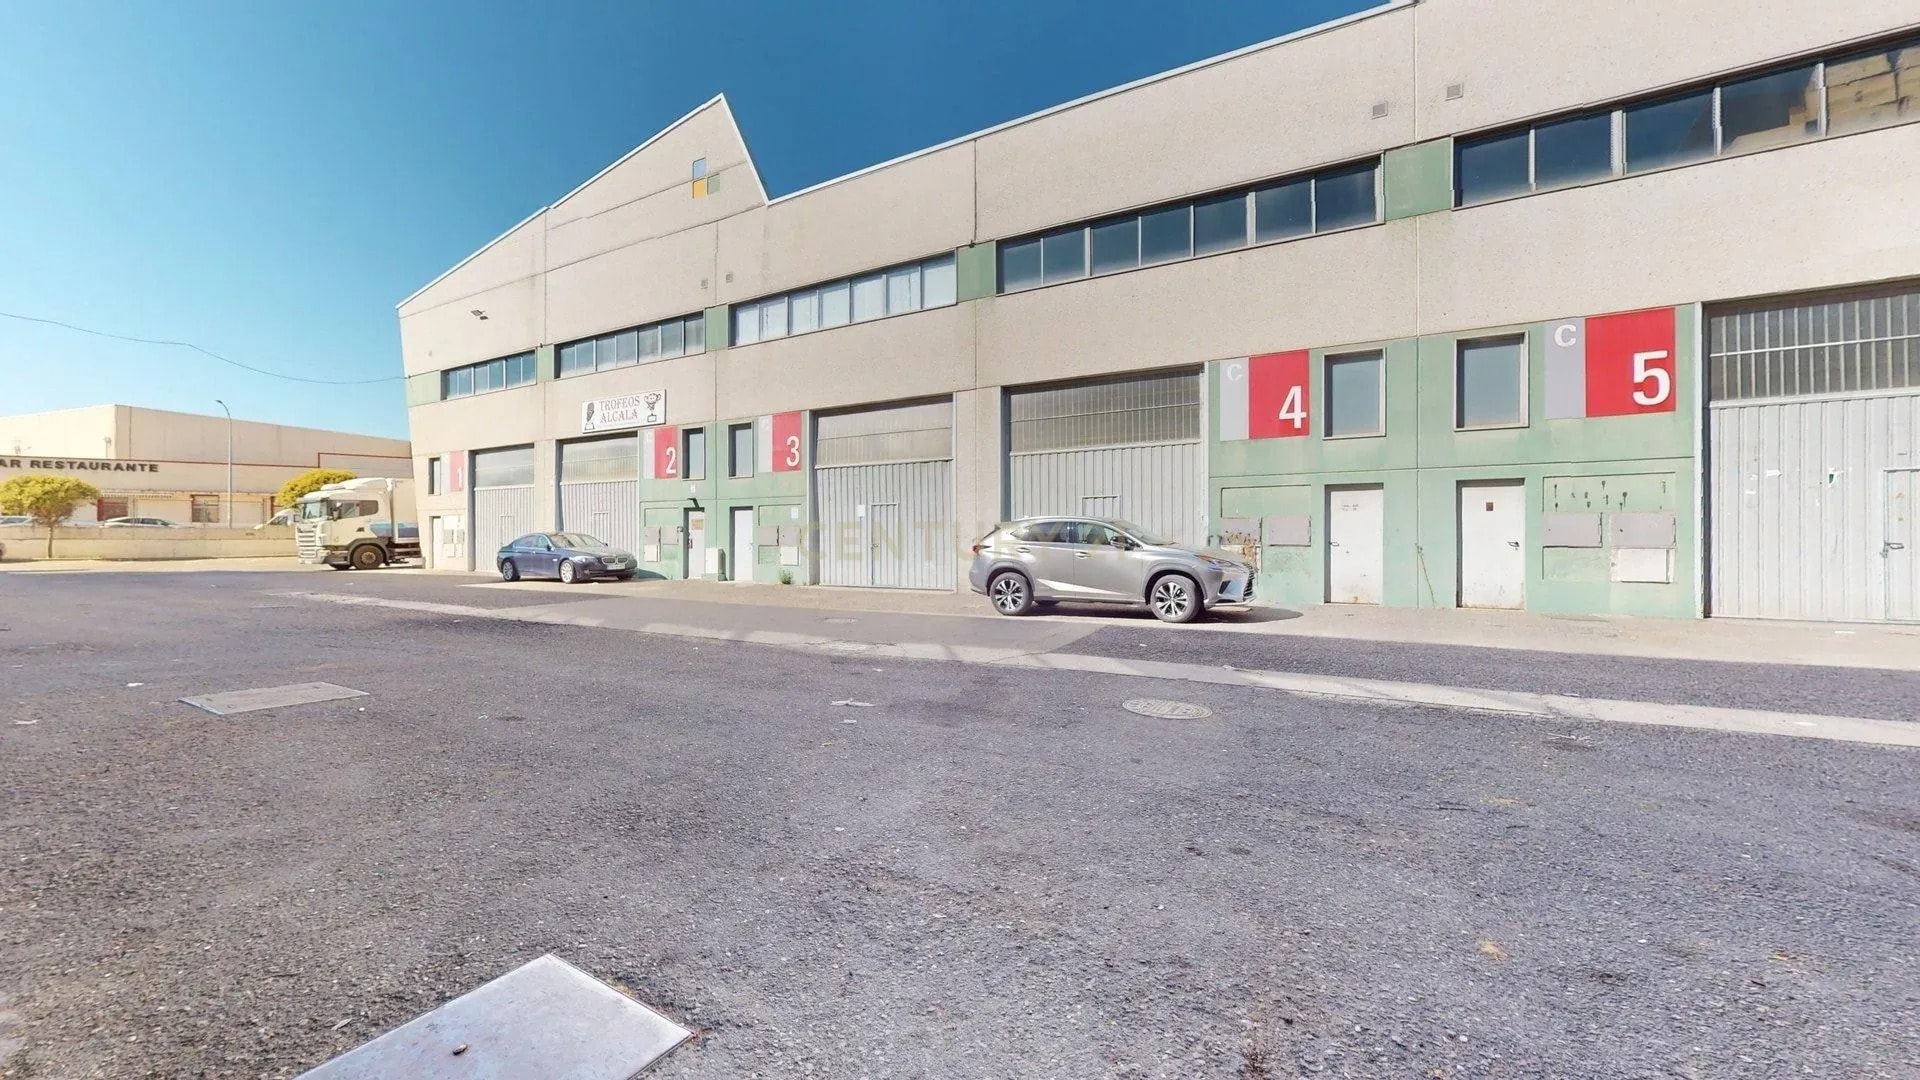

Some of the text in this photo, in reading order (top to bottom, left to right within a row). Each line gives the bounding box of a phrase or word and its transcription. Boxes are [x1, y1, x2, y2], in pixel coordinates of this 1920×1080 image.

[1554, 324, 1671, 406] C 5
[598, 396, 641, 412] TROFEOS
[1227, 363, 1307, 429] C 4
[665, 446, 677, 474] 2
[785, 435, 800, 467] 3
[30, 460, 160, 473] RESTAURANTE
[456, 467, 463, 488] 1
